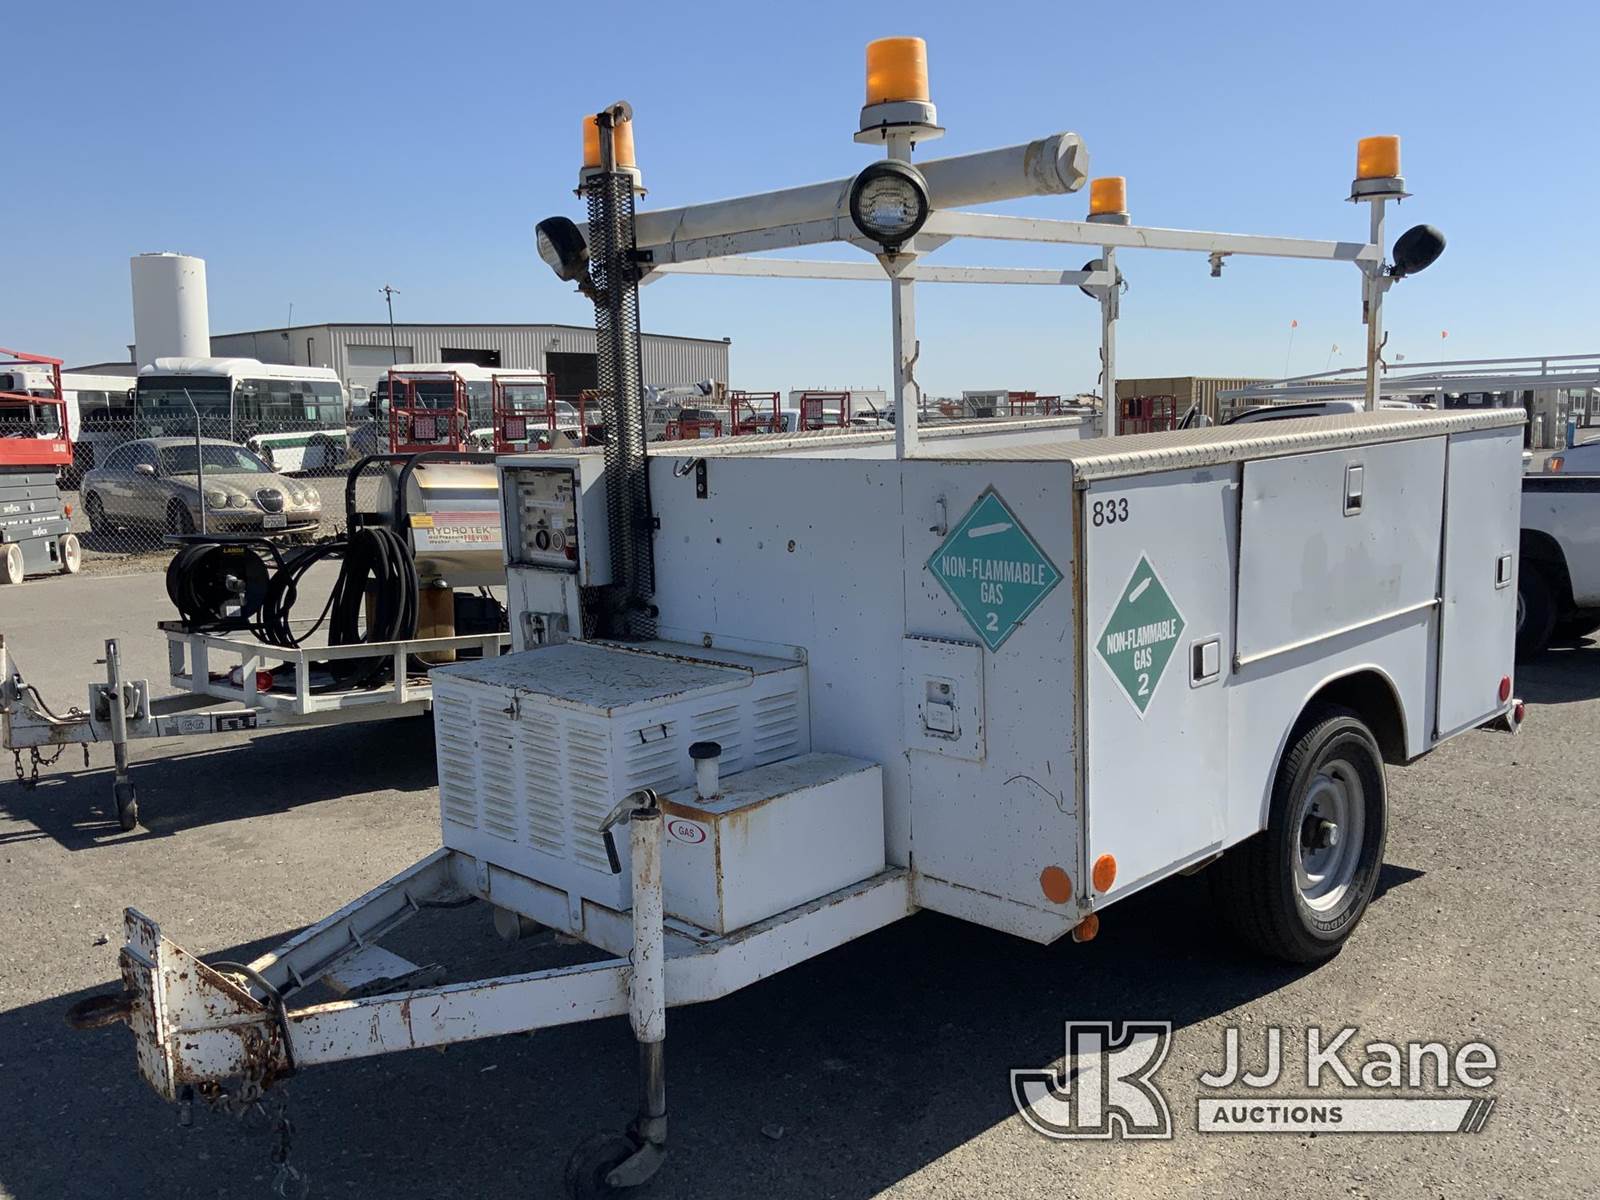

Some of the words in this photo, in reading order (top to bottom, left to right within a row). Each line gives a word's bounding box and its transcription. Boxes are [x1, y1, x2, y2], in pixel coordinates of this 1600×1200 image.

[1092, 497, 1129, 527] 833
[427, 527, 467, 535] HYDRO
[470, 526, 491, 534] TEK
[941, 555, 1046, 586] NON-FLAMMABLE
[980, 581, 1004, 605] GAS
[986, 612, 999, 632] 2
[1106, 618, 1177, 656] NON-FLAMMABLE
[1133, 647, 1153, 671] GAS
[1137, 673, 1150, 697] 2
[678, 826, 695, 838] GAS
